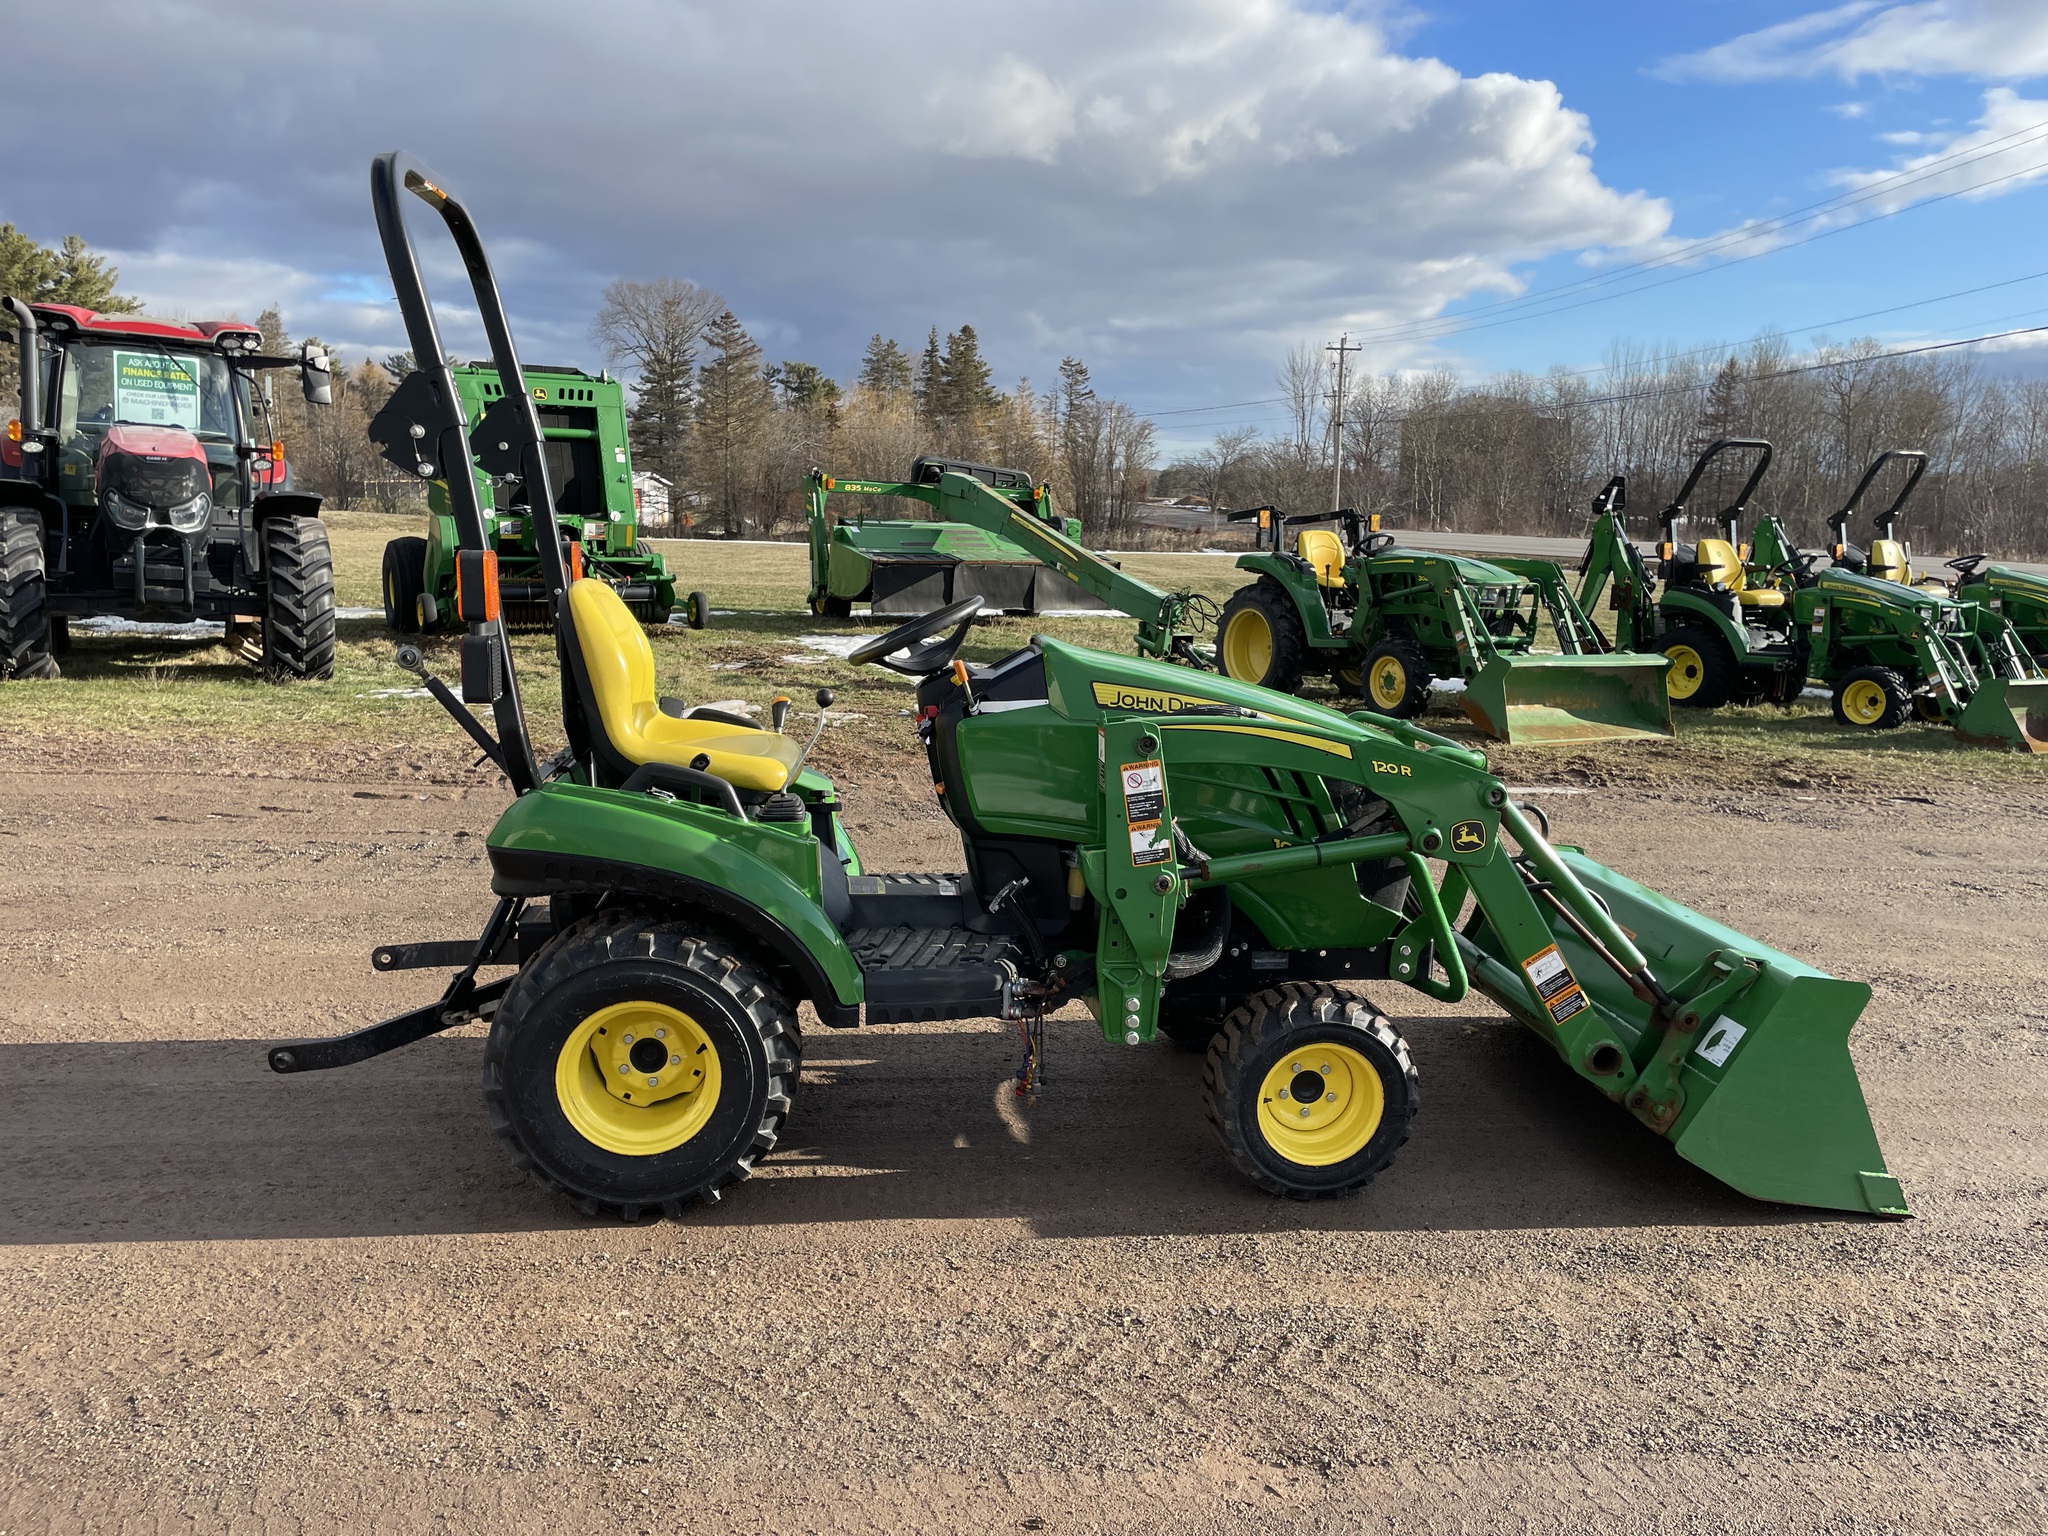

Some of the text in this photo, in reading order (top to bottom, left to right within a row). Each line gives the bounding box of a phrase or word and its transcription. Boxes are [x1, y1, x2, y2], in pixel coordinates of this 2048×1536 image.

[128, 359, 143, 367] ASK
[145, 360, 170, 369] ABOUT
[122, 367, 191, 381] FINANCE RATES
[121, 378, 193, 391] ON USED EQUIPMENT
[1110, 692, 1163, 710] JOHN
[1130, 761, 1158, 770] WARNING
